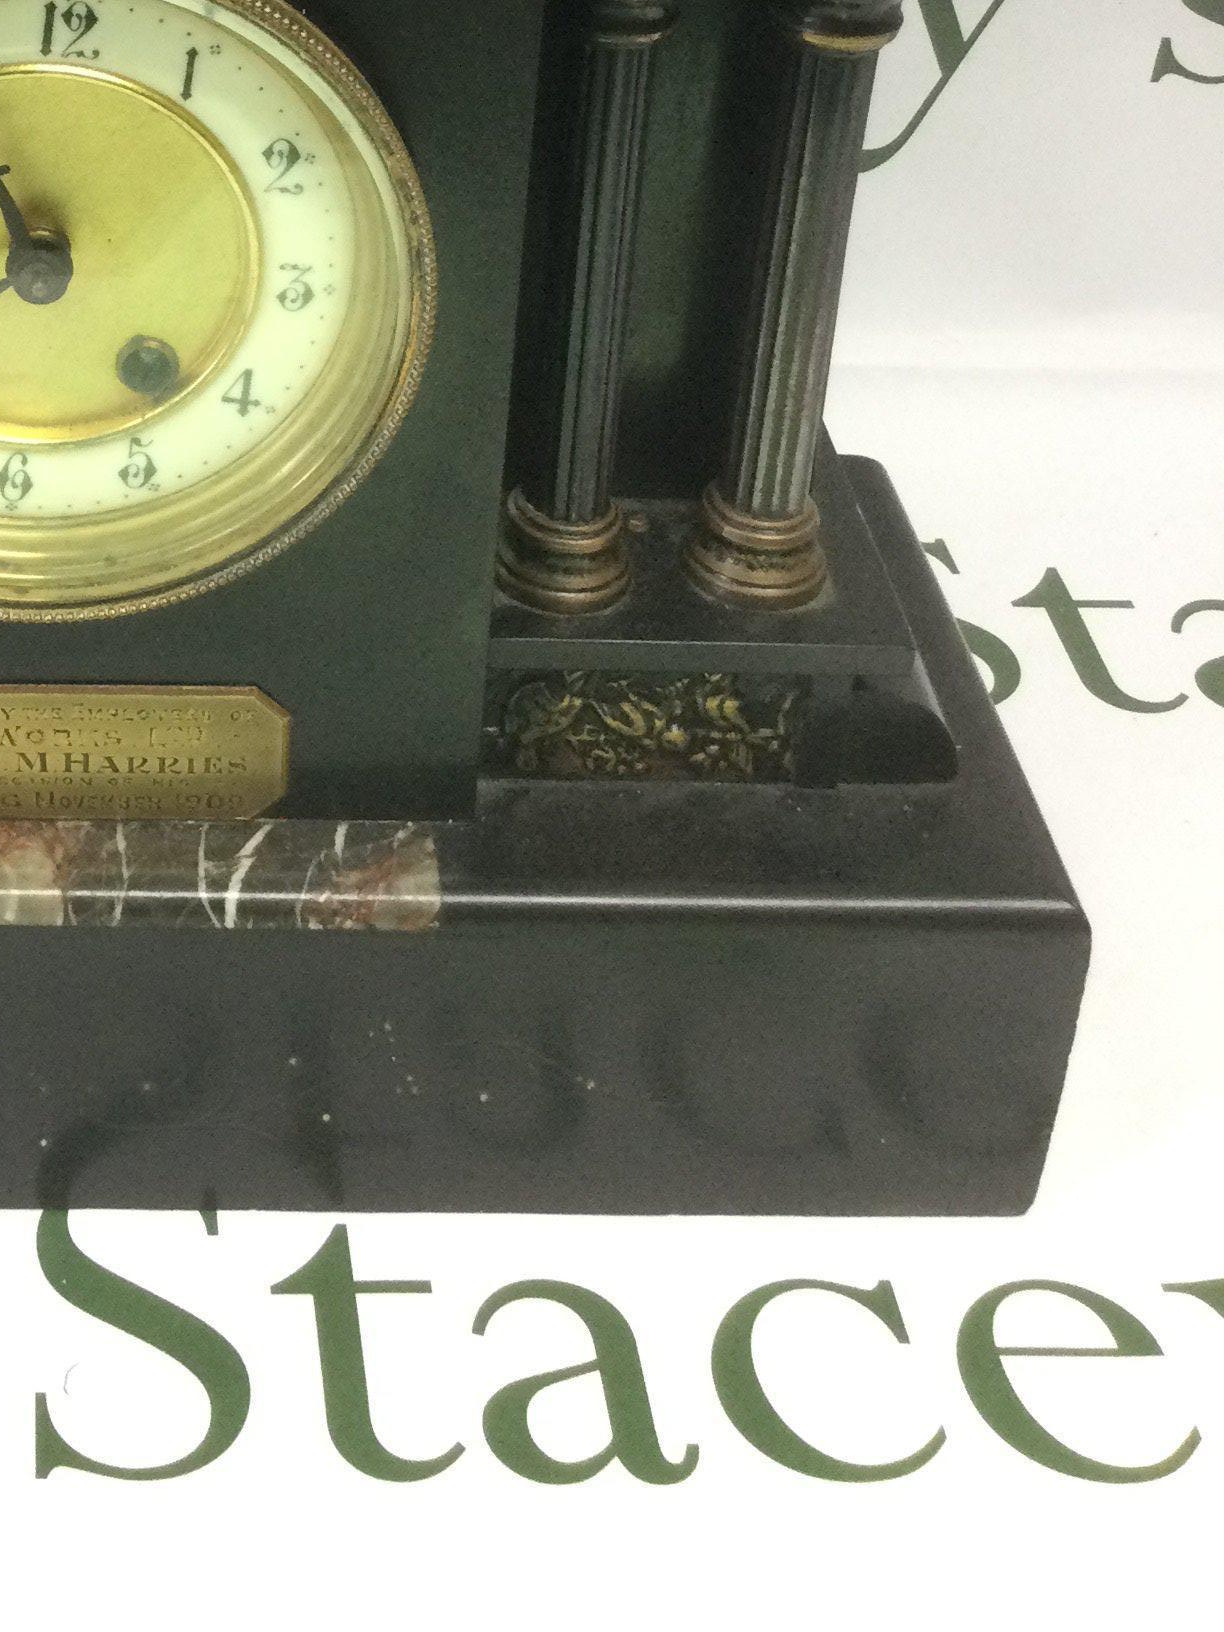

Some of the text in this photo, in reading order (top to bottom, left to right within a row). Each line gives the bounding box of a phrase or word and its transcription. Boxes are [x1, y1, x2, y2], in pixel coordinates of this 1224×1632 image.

[39, 0, 100, 59] 12
[182, 47, 199, 101] 1
[260, 138, 305, 195] 2
[276, 264, 314, 312] 3
[221, 367, 259, 418] 4
[117, 437, 159, 490] 5
[34, 1208, 1224, 1487] Stace
